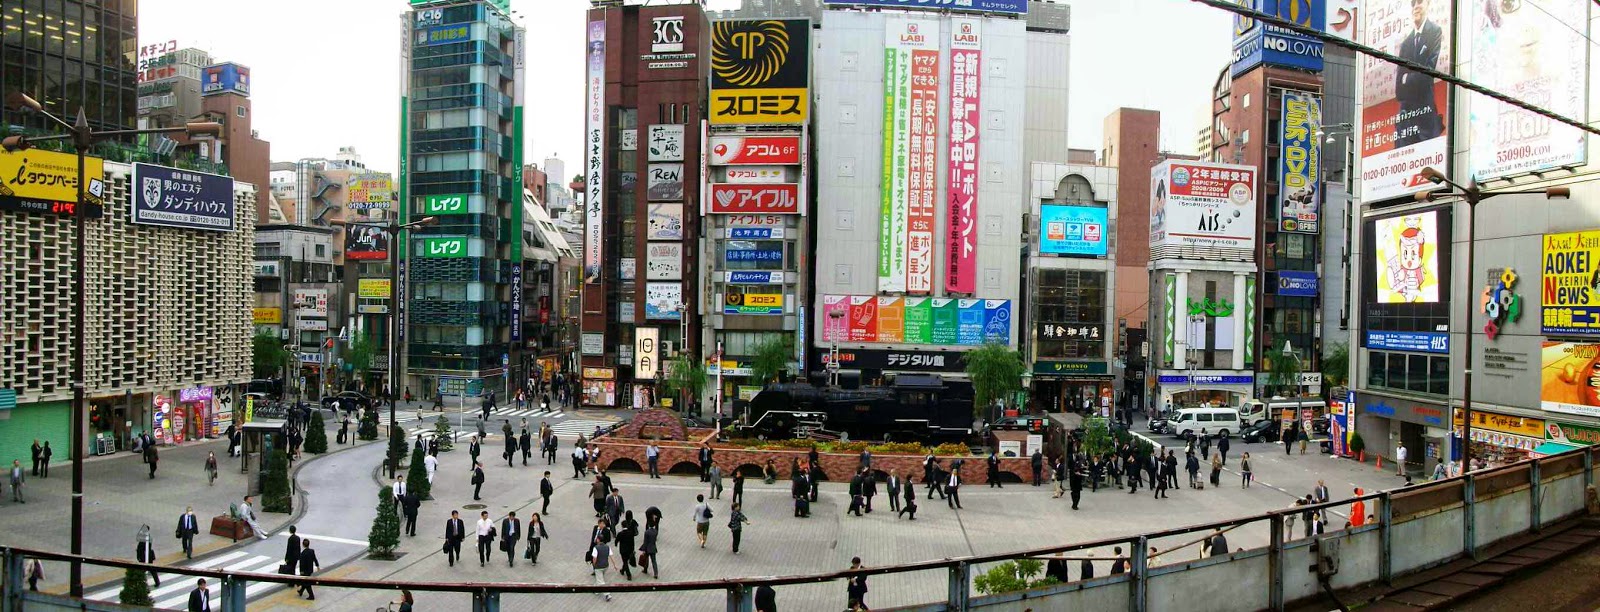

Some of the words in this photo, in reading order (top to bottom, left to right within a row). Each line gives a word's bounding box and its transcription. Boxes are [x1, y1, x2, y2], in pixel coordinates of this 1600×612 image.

[417, 9, 442, 22] K-16
[900, 34, 924, 42] LABI
[954, 34, 978, 42] LABI
[1372, 20, 1410, 44] 計画的に
[140, 40, 177, 57] パチンコ
[1264, 36, 1324, 58] NOLOAN
[914, 55, 937, 66] ヤマダ
[912, 76, 938, 86] できる!
[717, 96, 801, 116] プロミス
[746, 144, 780, 156] アコム
[783, 146, 796, 154] 6F
[1496, 145, 1550, 164] 550909.COM
[650, 166, 680, 182] REN
[1364, 162, 1406, 182] 0120-07-1000
[1409, 152, 1444, 170] acom.jp
[1192, 168, 1250, 182] 2年連続受賞
[164, 180, 203, 194] 男のエステ
[164, 195, 227, 214] ダンディハウス
[431, 198, 461, 211] レイク
[737, 189, 795, 208] アイフル
[140, 210, 188, 221] dandy-house.co.jp
[729, 216, 763, 224] アイフル
[766, 216, 781, 224] 5F
[430, 241, 460, 254] レイク
[1546, 236, 1572, 250] 大人気!
[727, 251, 782, 260] 店舗・事務所・土地・建物
[920, 236, 930, 288] ポイント
[1545, 250, 1590, 274] AOKEI
[1558, 276, 1590, 286] KEIRIN
[750, 296, 776, 304] プロミス
[888, 354, 945, 366] デジタル館
[214, 386, 231, 408] かつや
